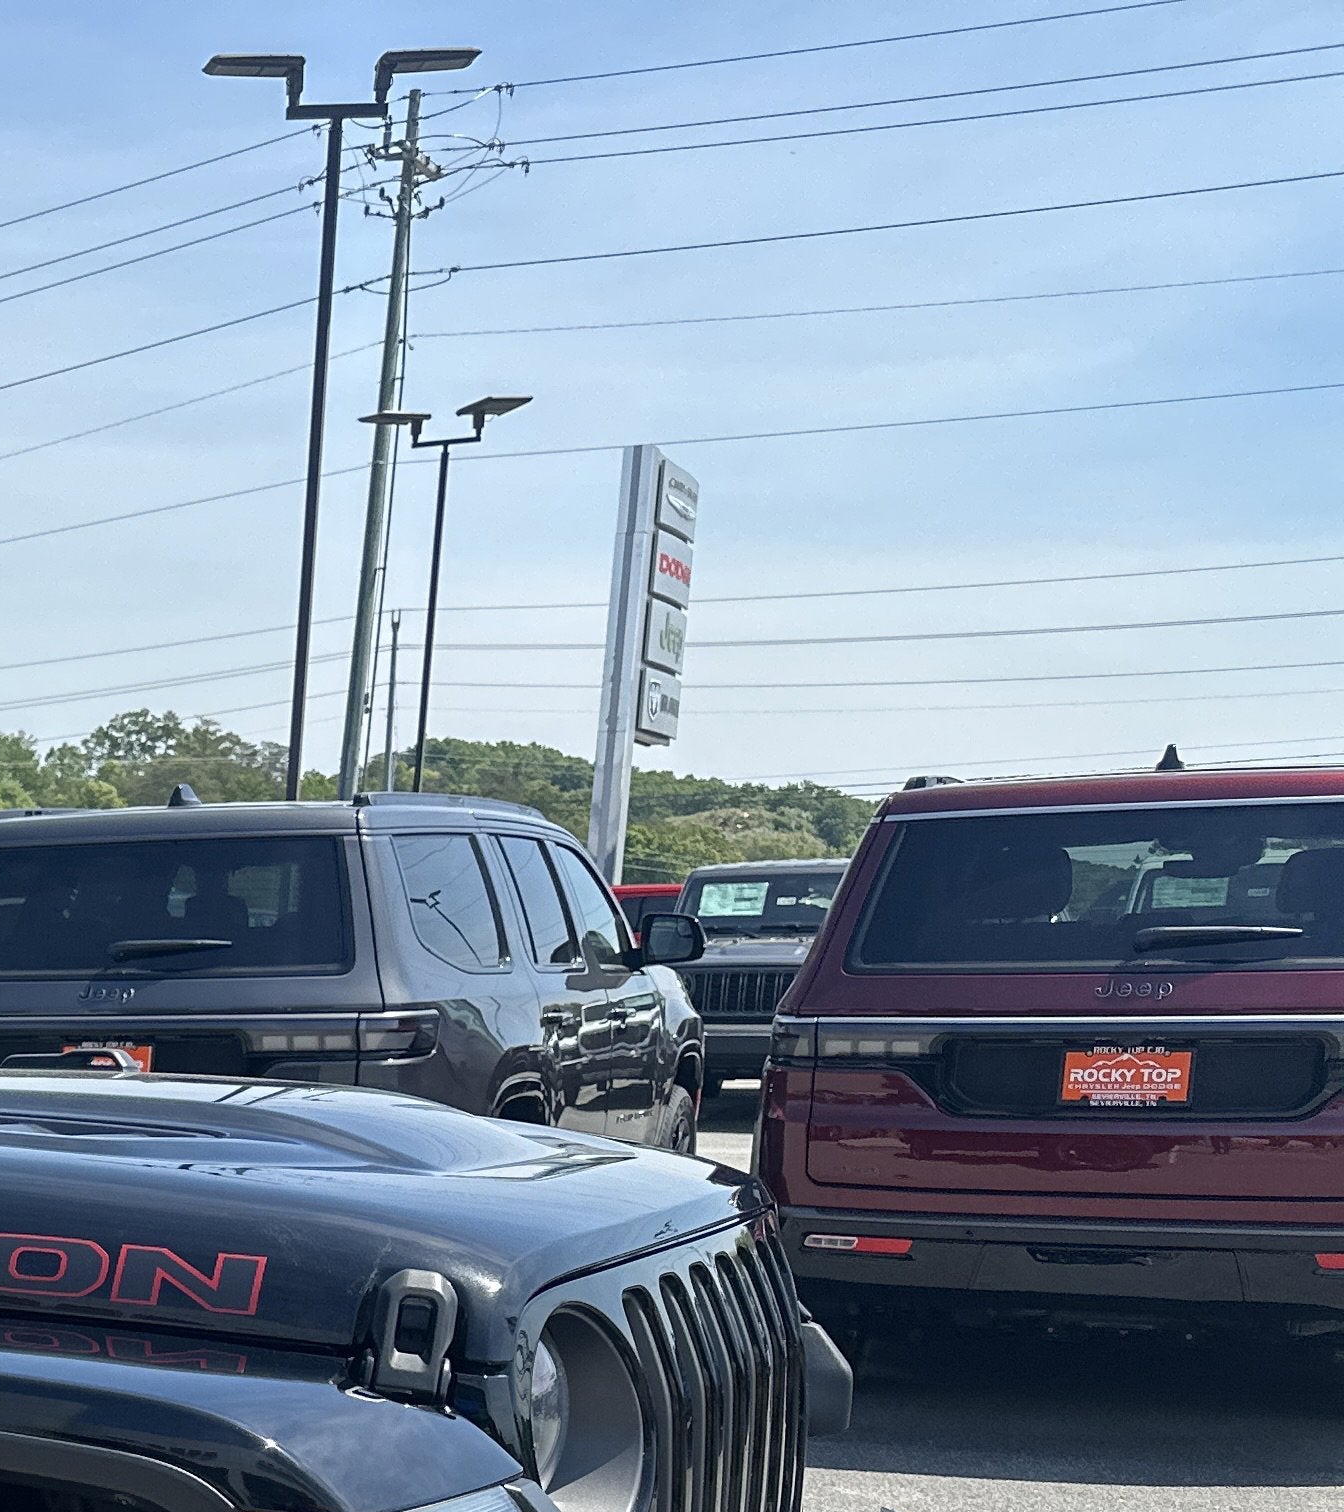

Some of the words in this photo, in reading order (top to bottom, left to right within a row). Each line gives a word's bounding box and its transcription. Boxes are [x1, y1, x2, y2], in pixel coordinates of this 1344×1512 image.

[78, 983, 136, 1004] Jeep
[1095, 979, 1173, 1001] Jeep
[1069, 1068, 1136, 1082] ROCKY
[1140, 1068, 1182, 1082] TOP
